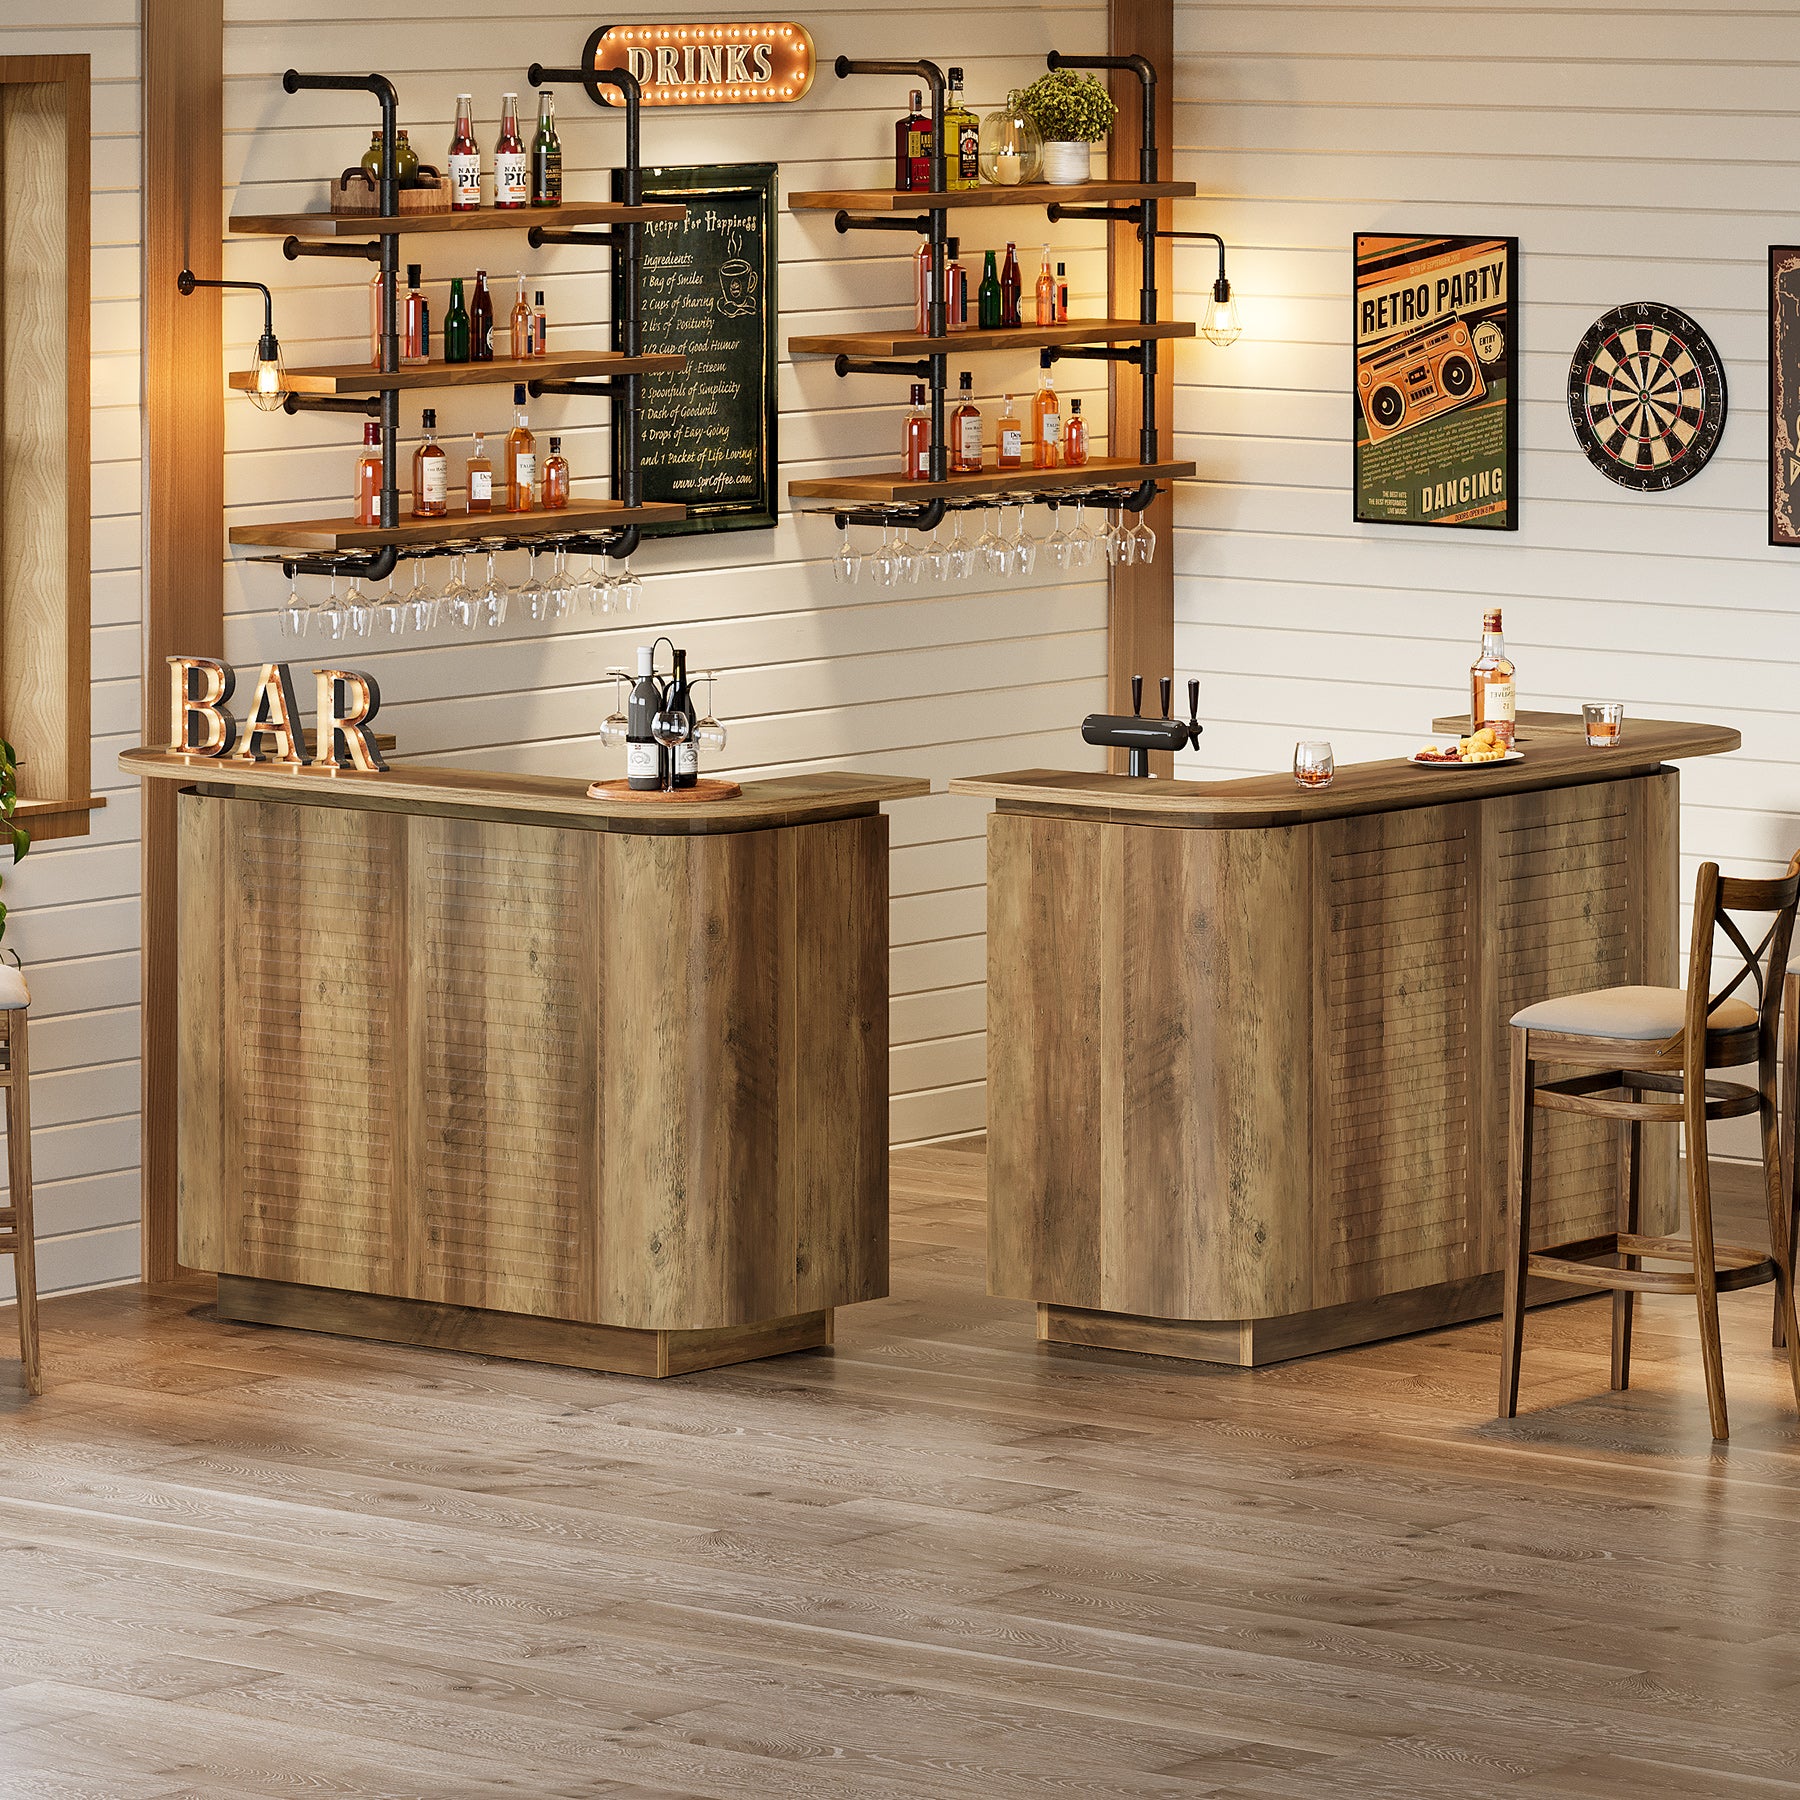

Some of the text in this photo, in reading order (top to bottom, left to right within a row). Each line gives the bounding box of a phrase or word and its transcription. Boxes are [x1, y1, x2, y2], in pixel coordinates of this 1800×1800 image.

[627, 44, 772, 86] DRINKS
[684, 209, 702, 234] For
[704, 210, 756, 236] Happiness
[643, 251, 694, 272] Ingredients:
[642, 270, 704, 294] 1 Bag of Smiles
[642, 294, 714, 317] 2 Cups of Sharing
[1361, 262, 1504, 336] RETRO PARTY
[642, 320, 648, 332] 2
[662, 317, 674, 340] of
[1480, 334, 1496, 346] ENTRY
[660, 343, 677, 354] Cup
[678, 339, 688, 356] of
[688, 338, 710, 354] Good
[710, 340, 740, 351] Humor
[642, 380, 741, 404] 2 Spoonfuls of Simplicity
[640, 402, 718, 426] 1 Dash of Goodwill
[642, 424, 730, 446] 4 Drops of Easy-Going
[640, 452, 660, 466] and
[660, 454, 666, 464] 1
[668, 449, 695, 464] Packet
[696, 448, 708, 470] of
[708, 447, 725, 468] Life
[1422, 468, 1502, 514] DANCING
[166, 655, 390, 772] BAR
